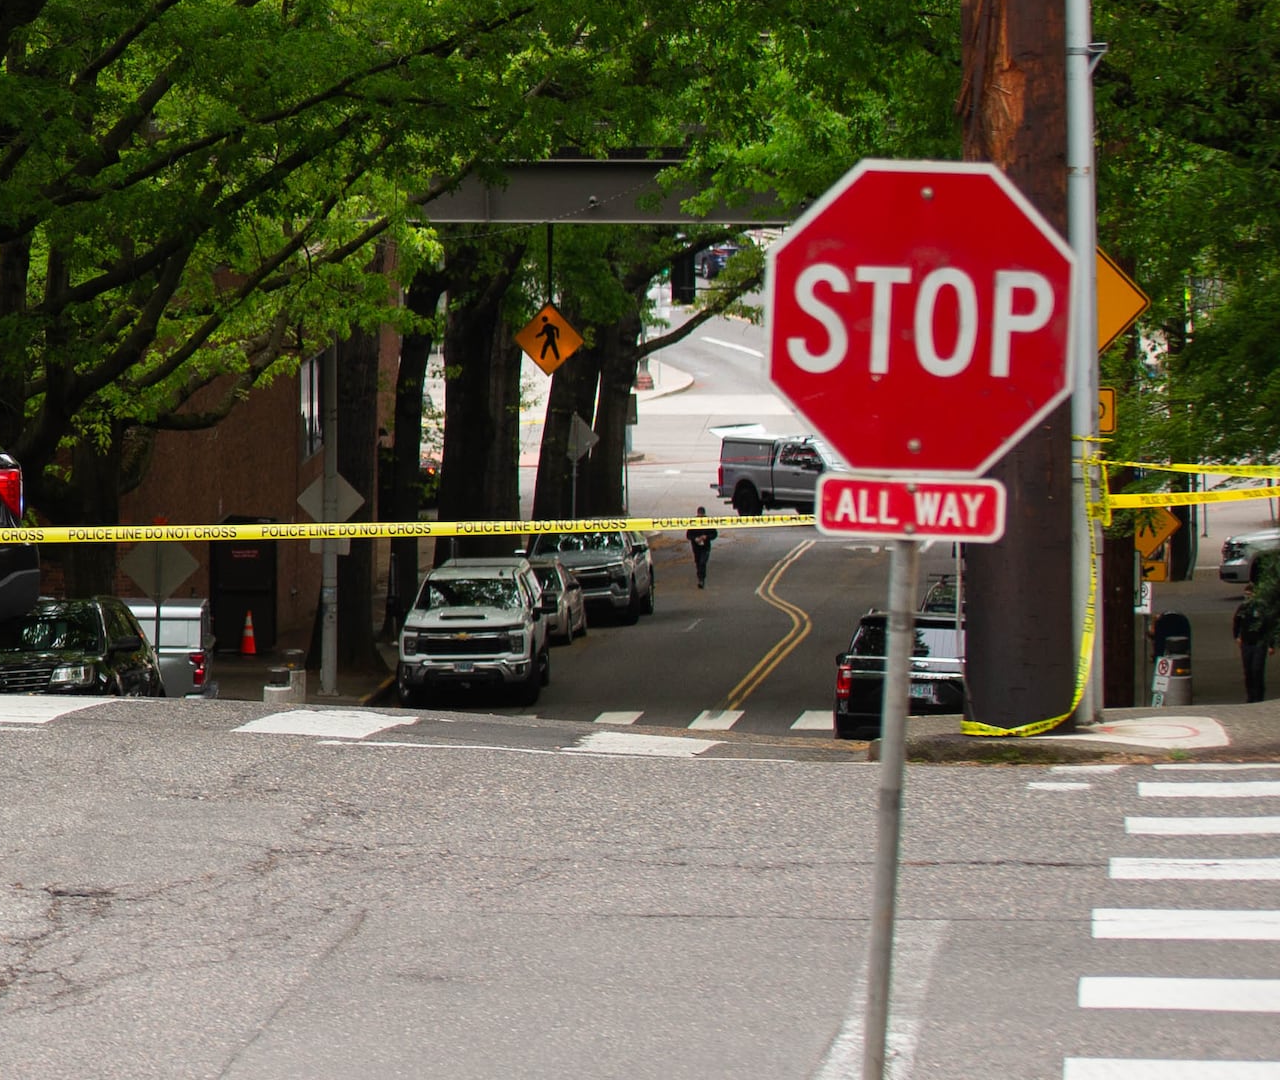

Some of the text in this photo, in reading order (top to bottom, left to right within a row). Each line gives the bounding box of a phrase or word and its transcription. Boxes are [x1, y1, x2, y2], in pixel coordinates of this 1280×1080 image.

[786, 262, 1054, 378] STOP
[834, 486, 986, 527] ALL WAY
[261, 523, 431, 537] POLICE LINE DO NOT CROSS
[456, 519, 627, 532] POLICE LINE DO NOT CROSS
[2, 530, 44, 541] CROSS
[69, 527, 237, 540] POLICE LINE DO NOT CROSS
